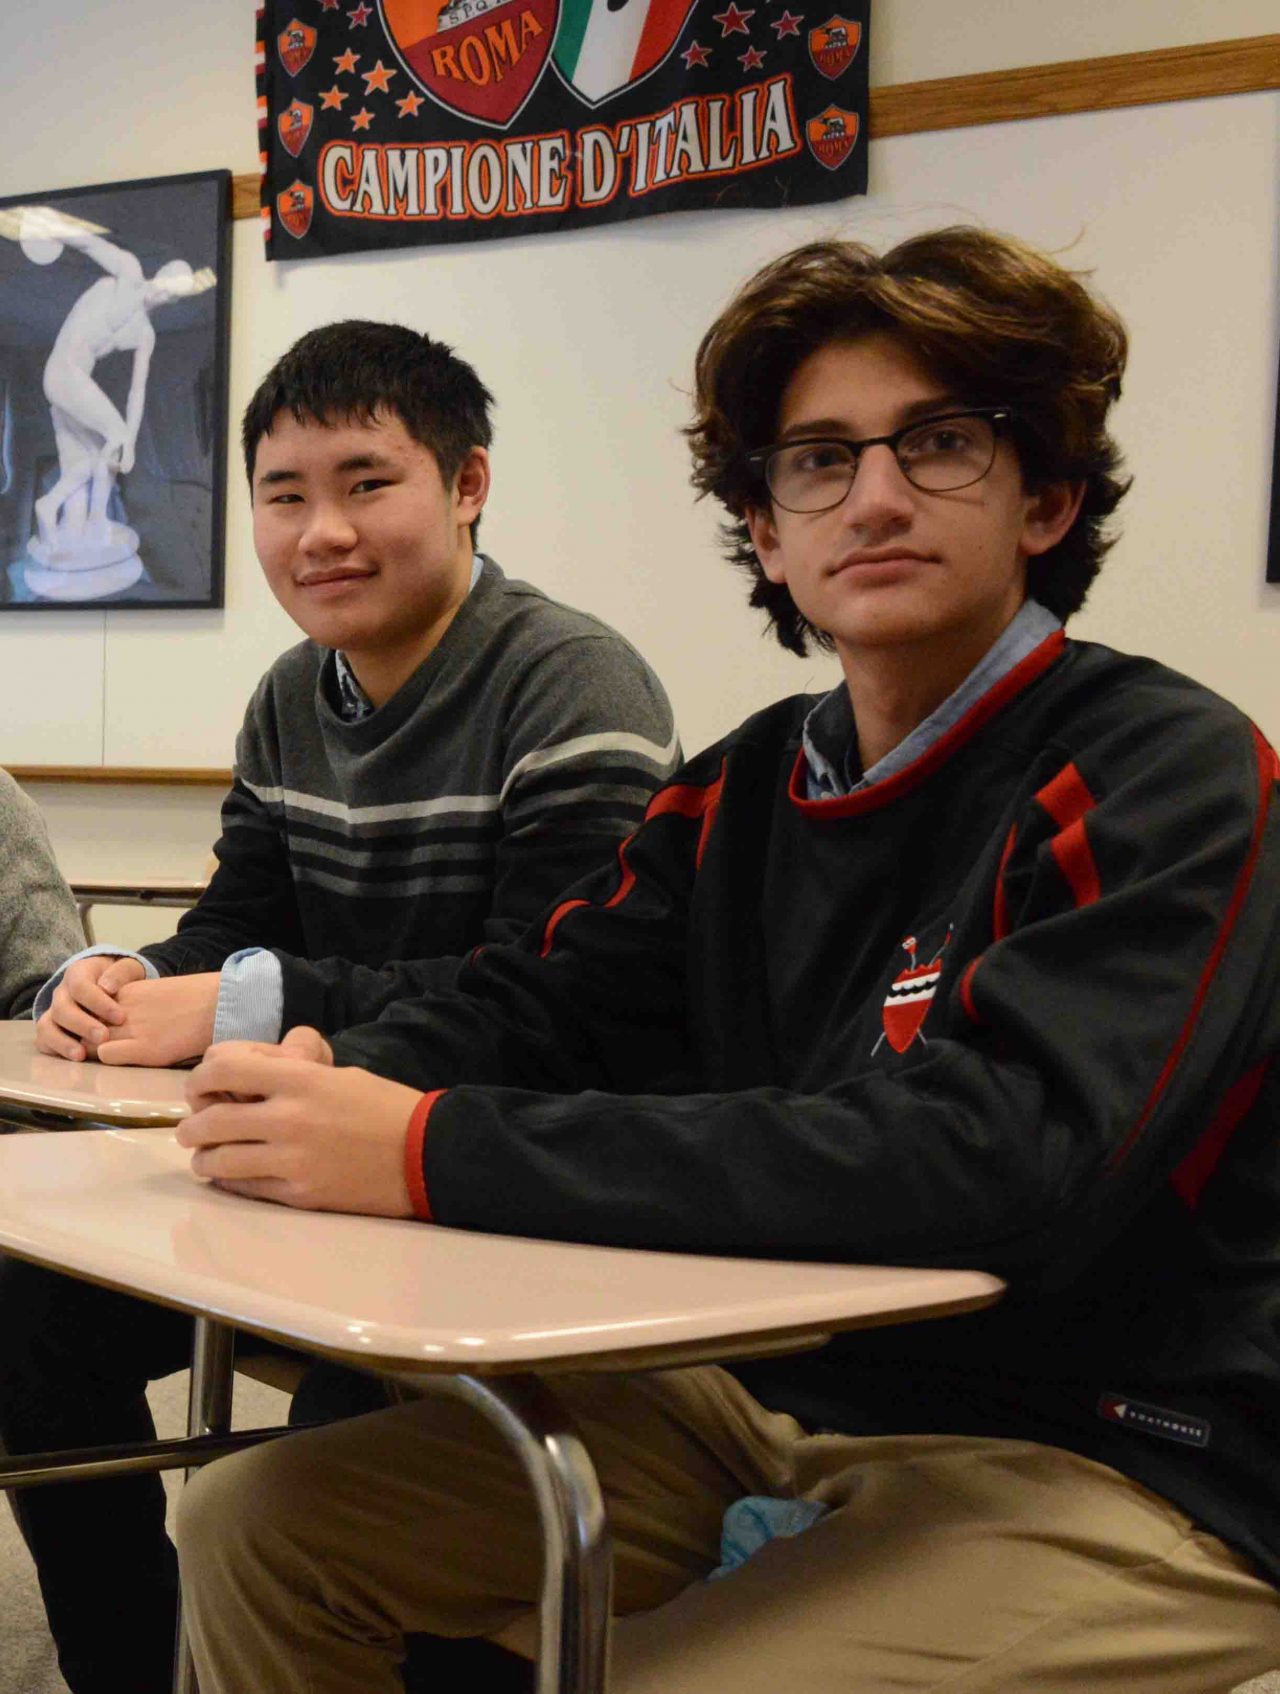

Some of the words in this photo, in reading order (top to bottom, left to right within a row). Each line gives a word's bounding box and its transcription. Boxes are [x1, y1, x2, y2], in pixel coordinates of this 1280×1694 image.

[431, 10, 543, 87] ROMA
[322, 134, 567, 218] CAMPIONE
[580, 79, 798, 203] D'ITALIA
